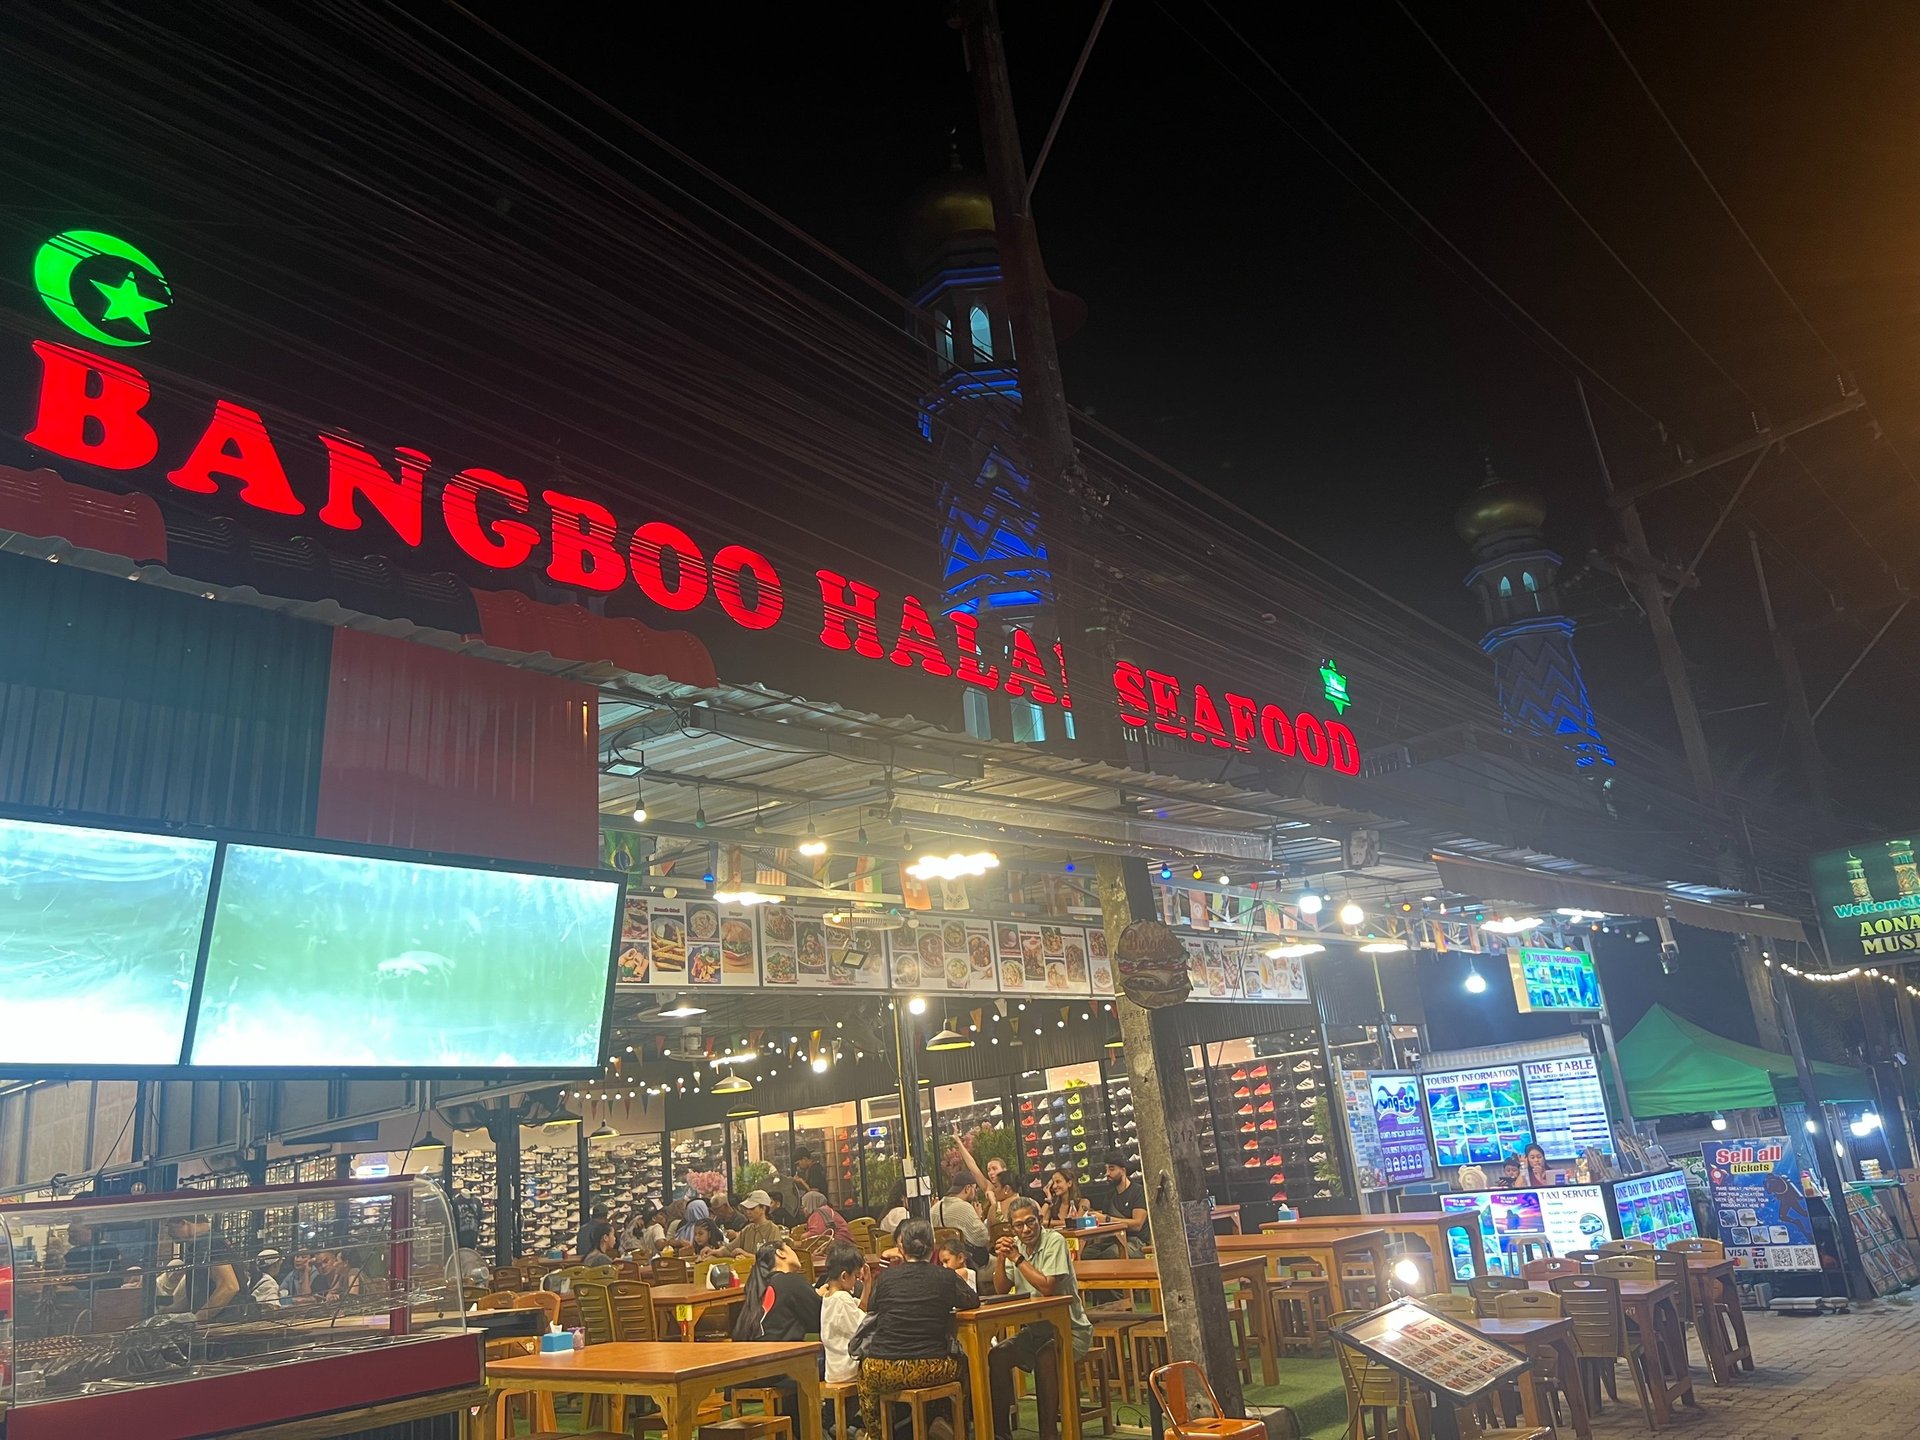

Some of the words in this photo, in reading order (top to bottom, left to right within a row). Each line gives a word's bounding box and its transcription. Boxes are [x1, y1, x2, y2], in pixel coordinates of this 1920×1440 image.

[24, 339, 784, 631] BANGBOO
[1113, 660, 1362, 777] SEAFOOD
[1833, 897, 1911, 918] Welcome
[1526, 1062, 1553, 1075] TIME
[1556, 1059, 1594, 1072] TABLE
[1426, 1075, 1460, 1086] TOURIST
[1461, 1068, 1519, 1082] INFORMATION
[1716, 1147, 1753, 1164] Sell
[1757, 1145, 1781, 1162] all
[1733, 1163, 1770, 1173] tickets
[1540, 1190, 1560, 1200] TAXI
[1562, 1188, 1600, 1199] SERVICE
[1615, 1186, 1629, 1199] ONE
[1628, 1183, 1640, 1197] DAY
[1727, 1248, 1749, 1257] VISA
